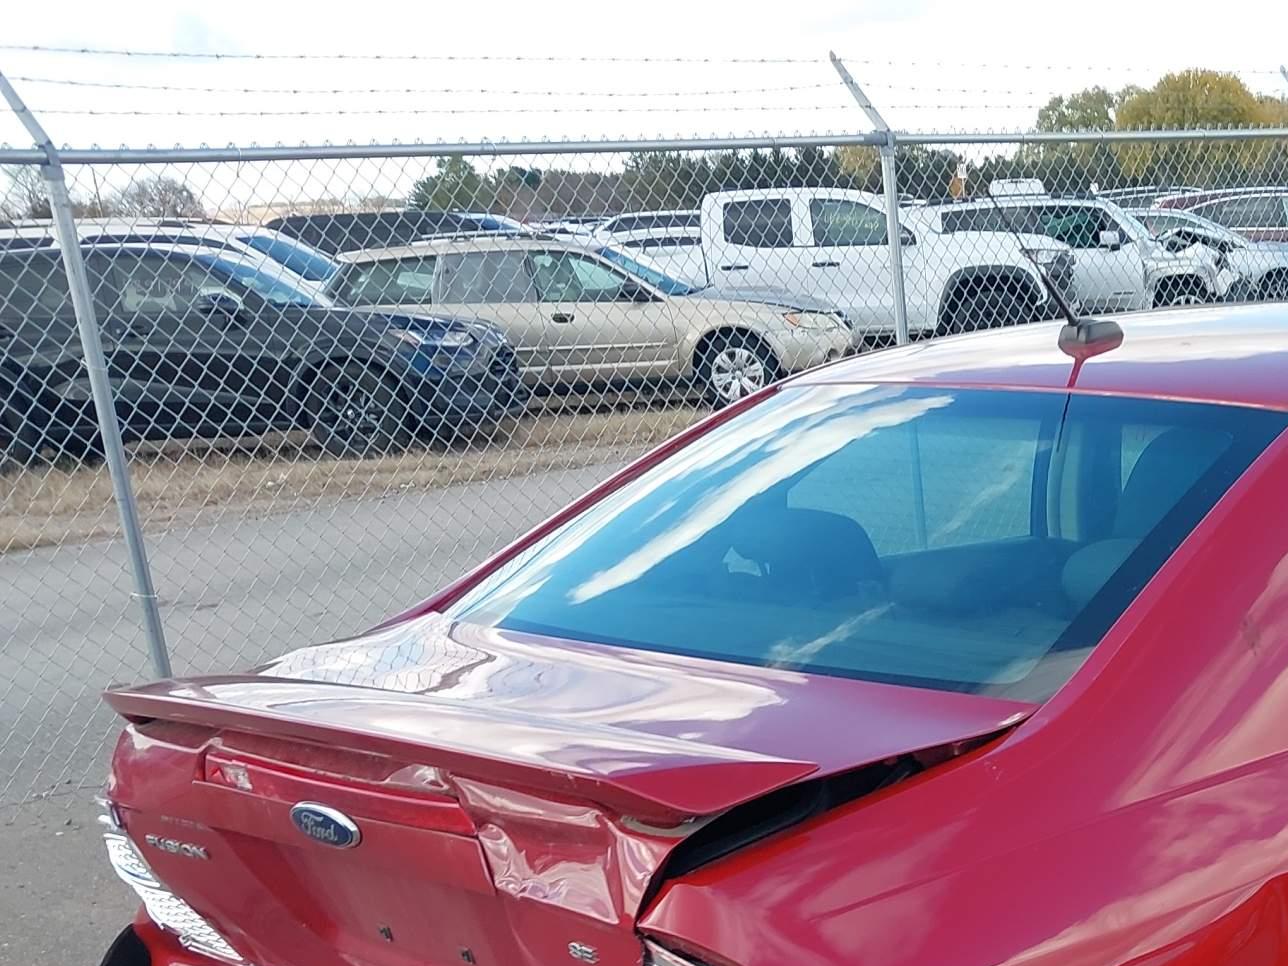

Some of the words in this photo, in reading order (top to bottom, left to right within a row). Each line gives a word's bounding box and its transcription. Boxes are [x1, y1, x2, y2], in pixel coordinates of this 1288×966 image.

[301, 811, 338, 841] Ford
[145, 833, 209, 860] FUSION
[568, 941, 600, 965] SE
